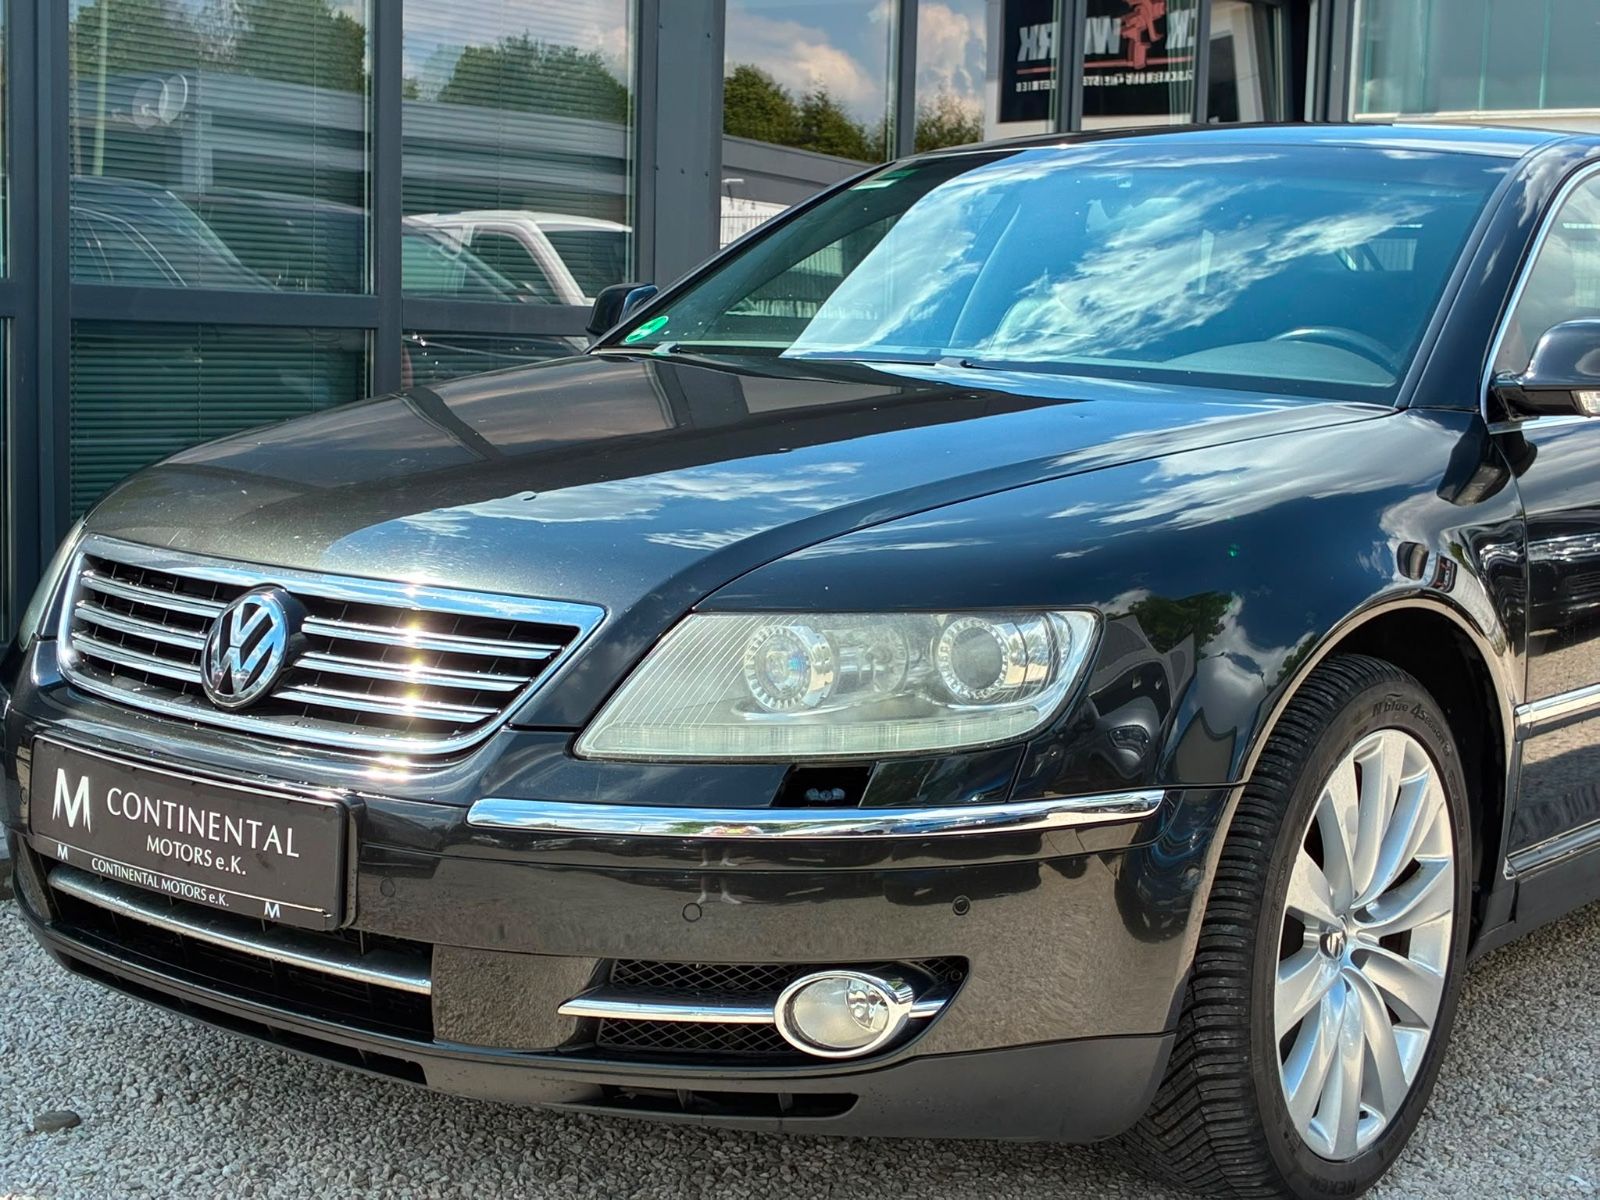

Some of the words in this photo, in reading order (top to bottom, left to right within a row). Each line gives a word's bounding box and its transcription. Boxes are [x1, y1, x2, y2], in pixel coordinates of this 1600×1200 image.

[106, 787, 300, 858] CONTINENTAL
[146, 834, 213, 867] MOTORS
[215, 854, 247, 875] e.K.
[91, 857, 159, 889] CONTINENTAL
[160, 878, 207, 901] MOTORS
[208, 891, 230, 907] e.K.
